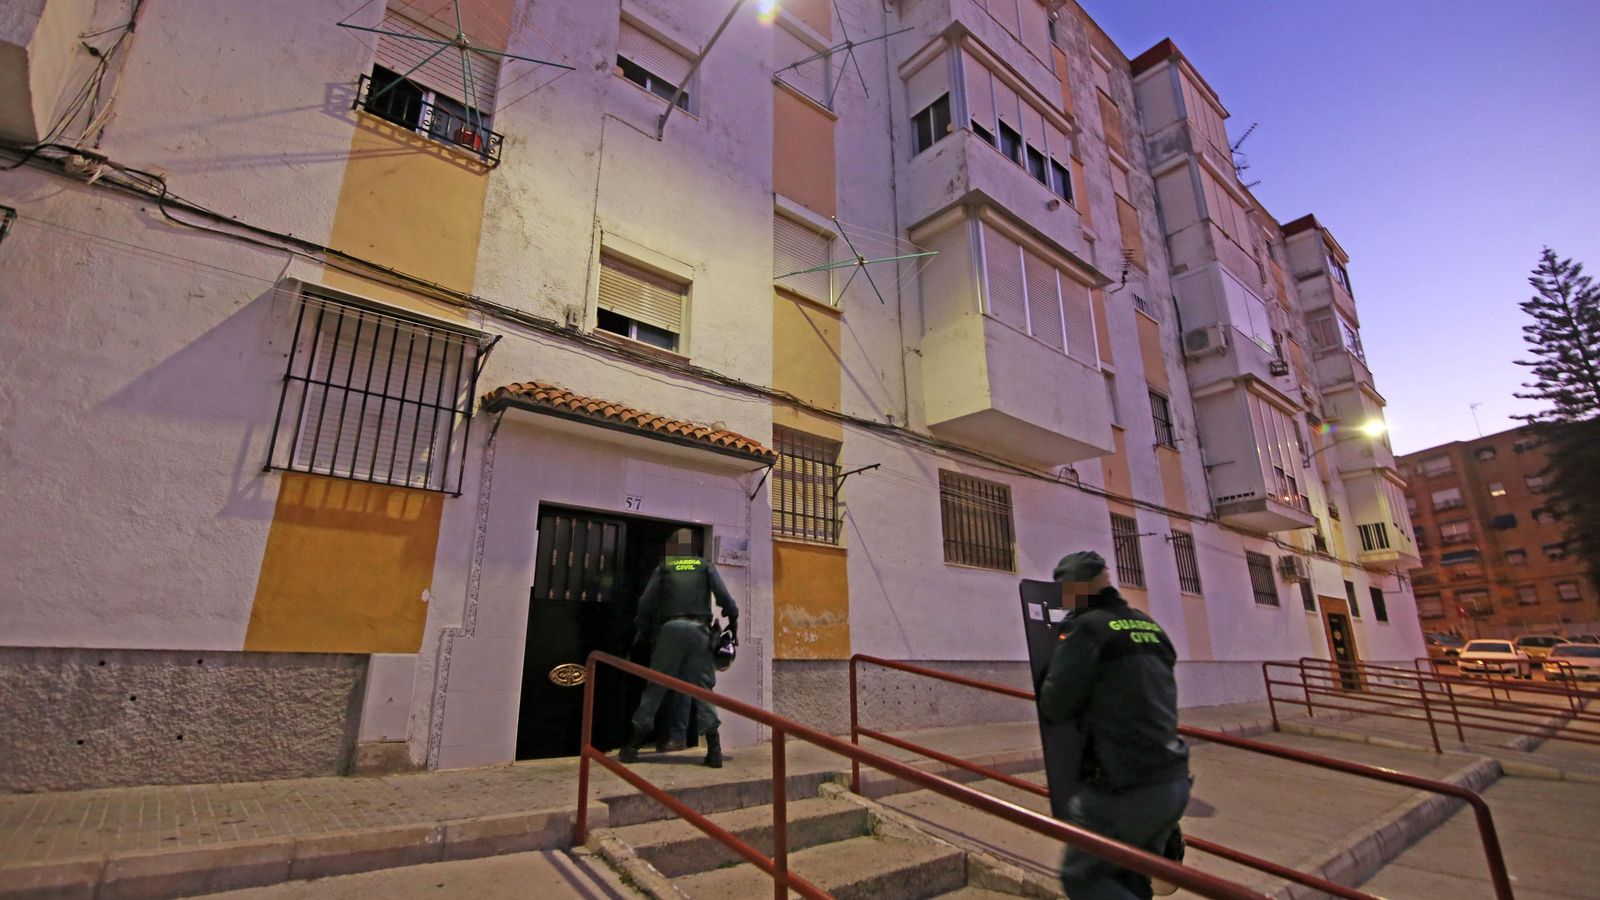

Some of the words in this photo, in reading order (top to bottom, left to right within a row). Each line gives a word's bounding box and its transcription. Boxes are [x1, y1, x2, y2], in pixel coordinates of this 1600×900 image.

[626, 496, 642, 510] 57
[1108, 619, 1162, 632] GUARDIA
[1130, 631, 1161, 643] CIVIL
